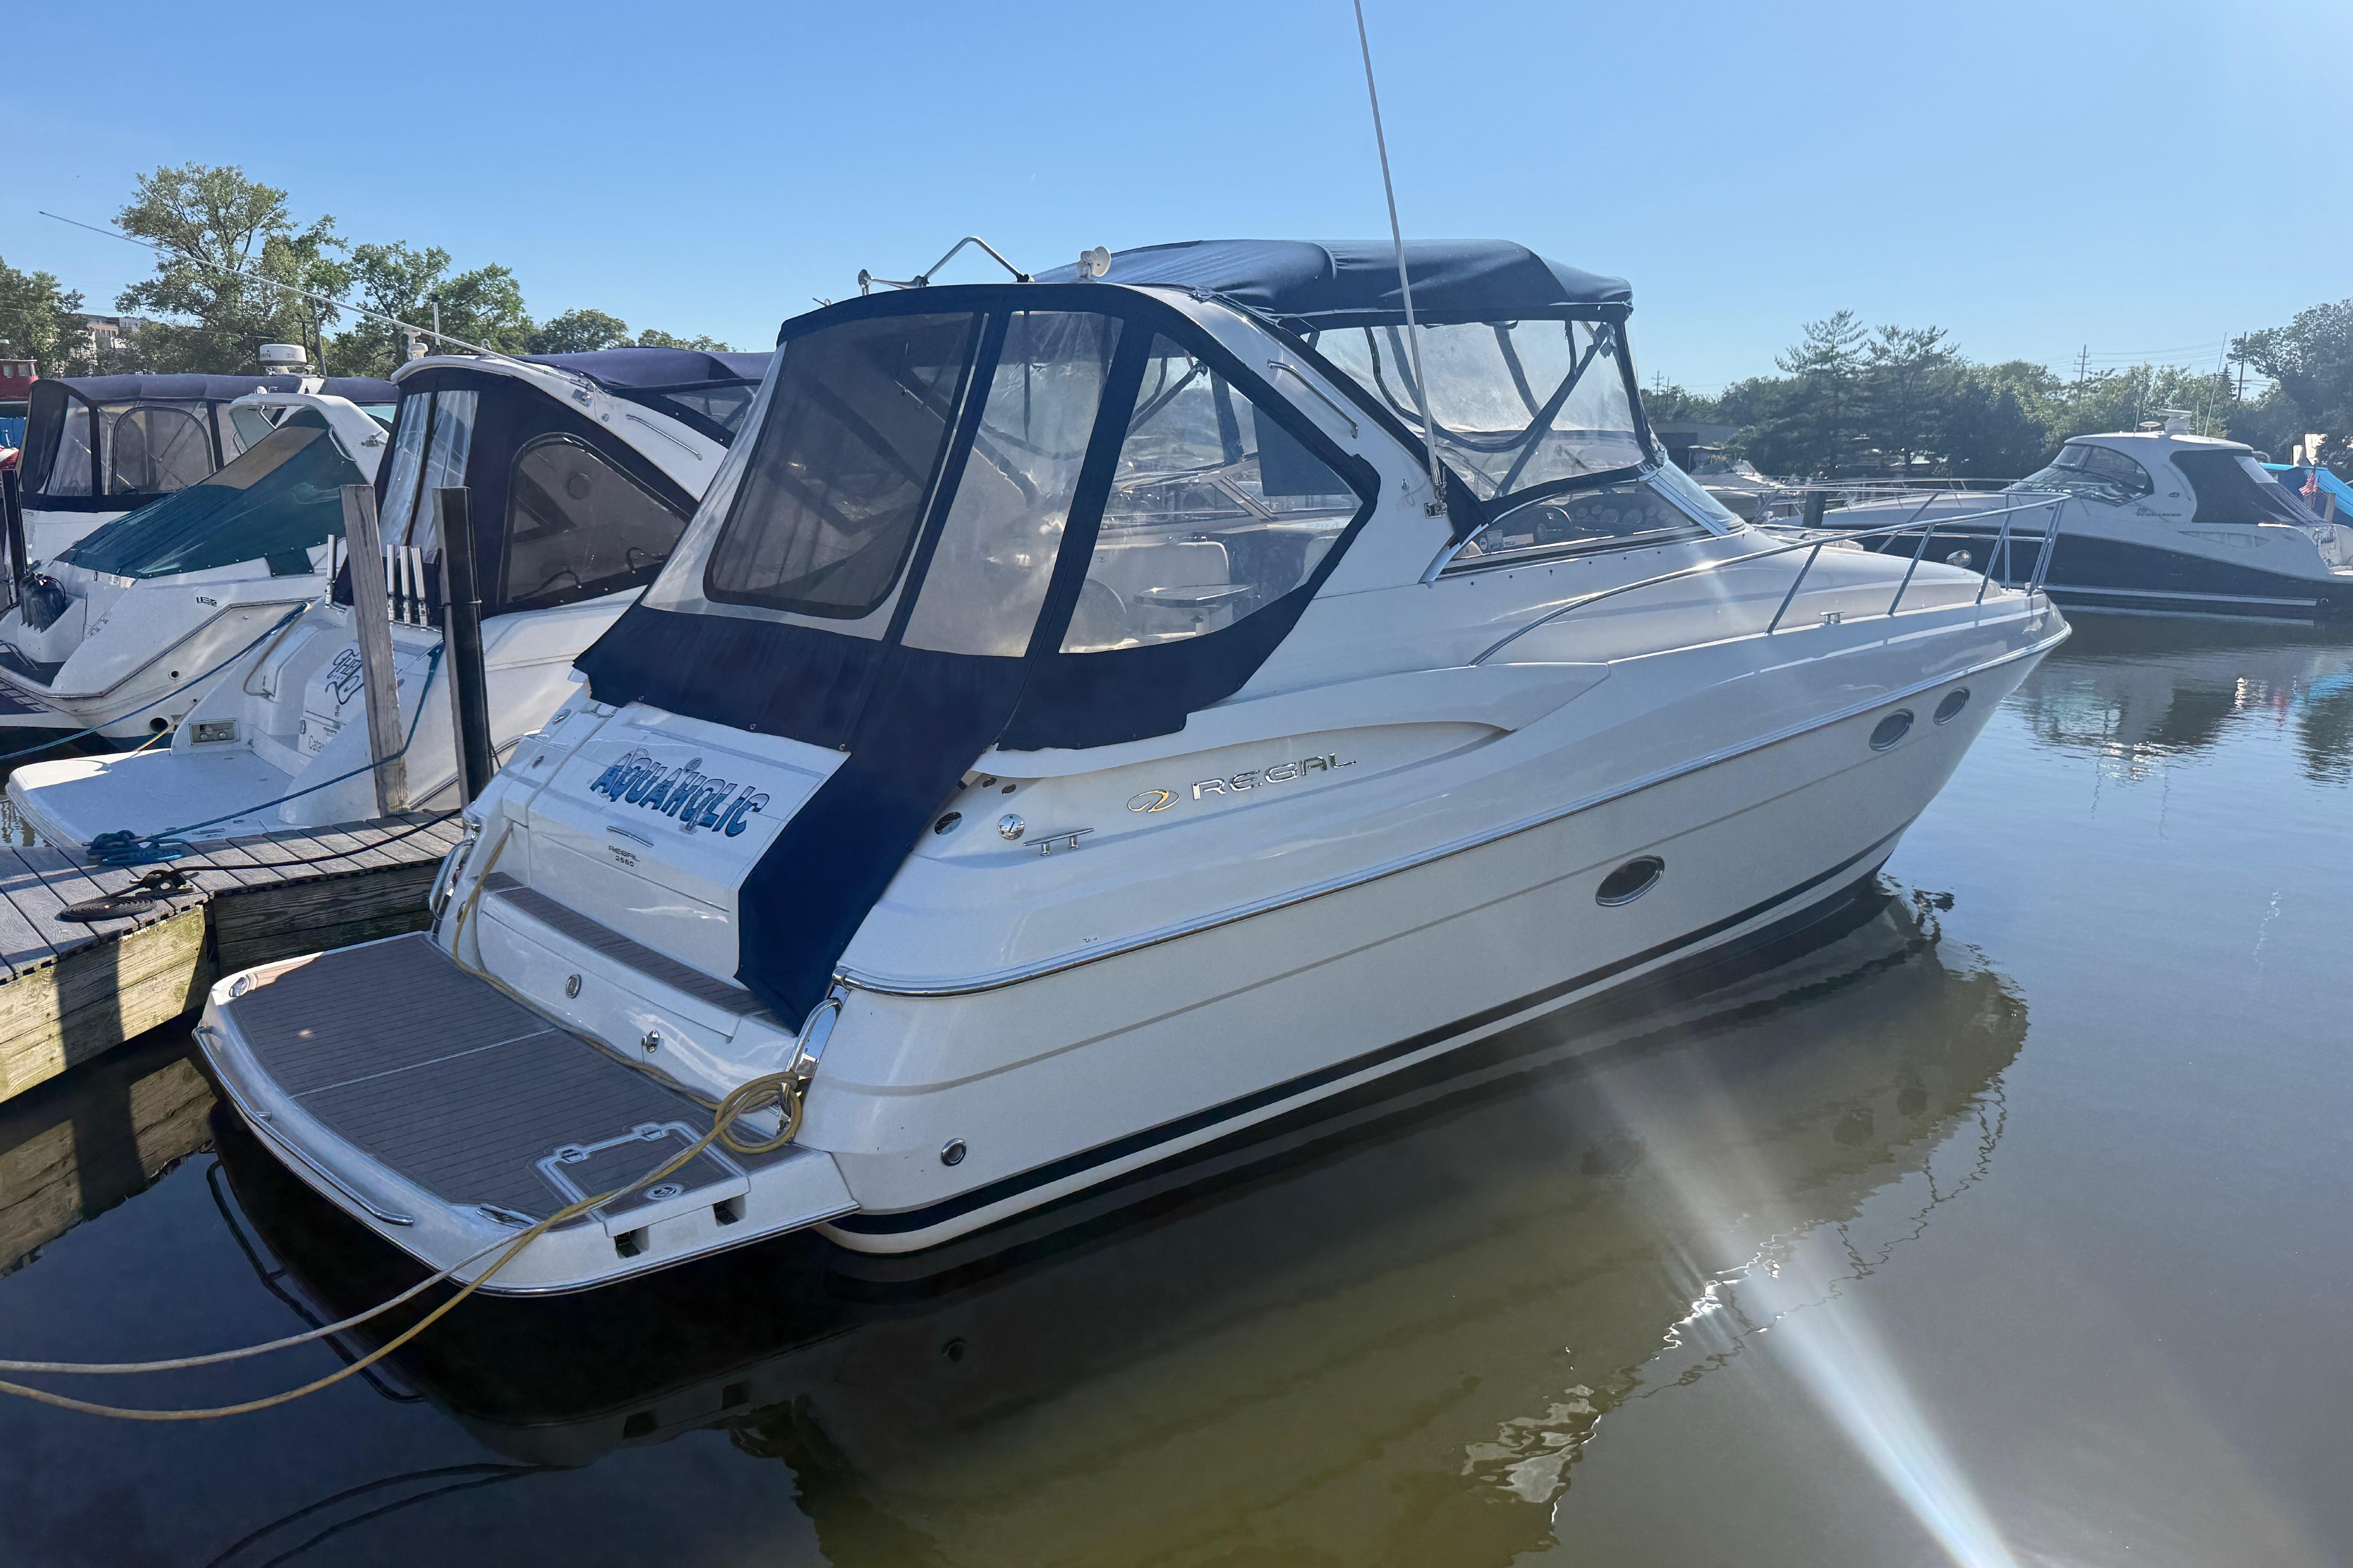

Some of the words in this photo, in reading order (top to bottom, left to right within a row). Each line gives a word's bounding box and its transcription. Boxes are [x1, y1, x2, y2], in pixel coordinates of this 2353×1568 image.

[1192, 752, 1356, 800] REGAL
[590, 753, 770, 837] AQUAHOLIC
[609, 845, 640, 862] REGAL
[615, 856, 634, 867] 3560
